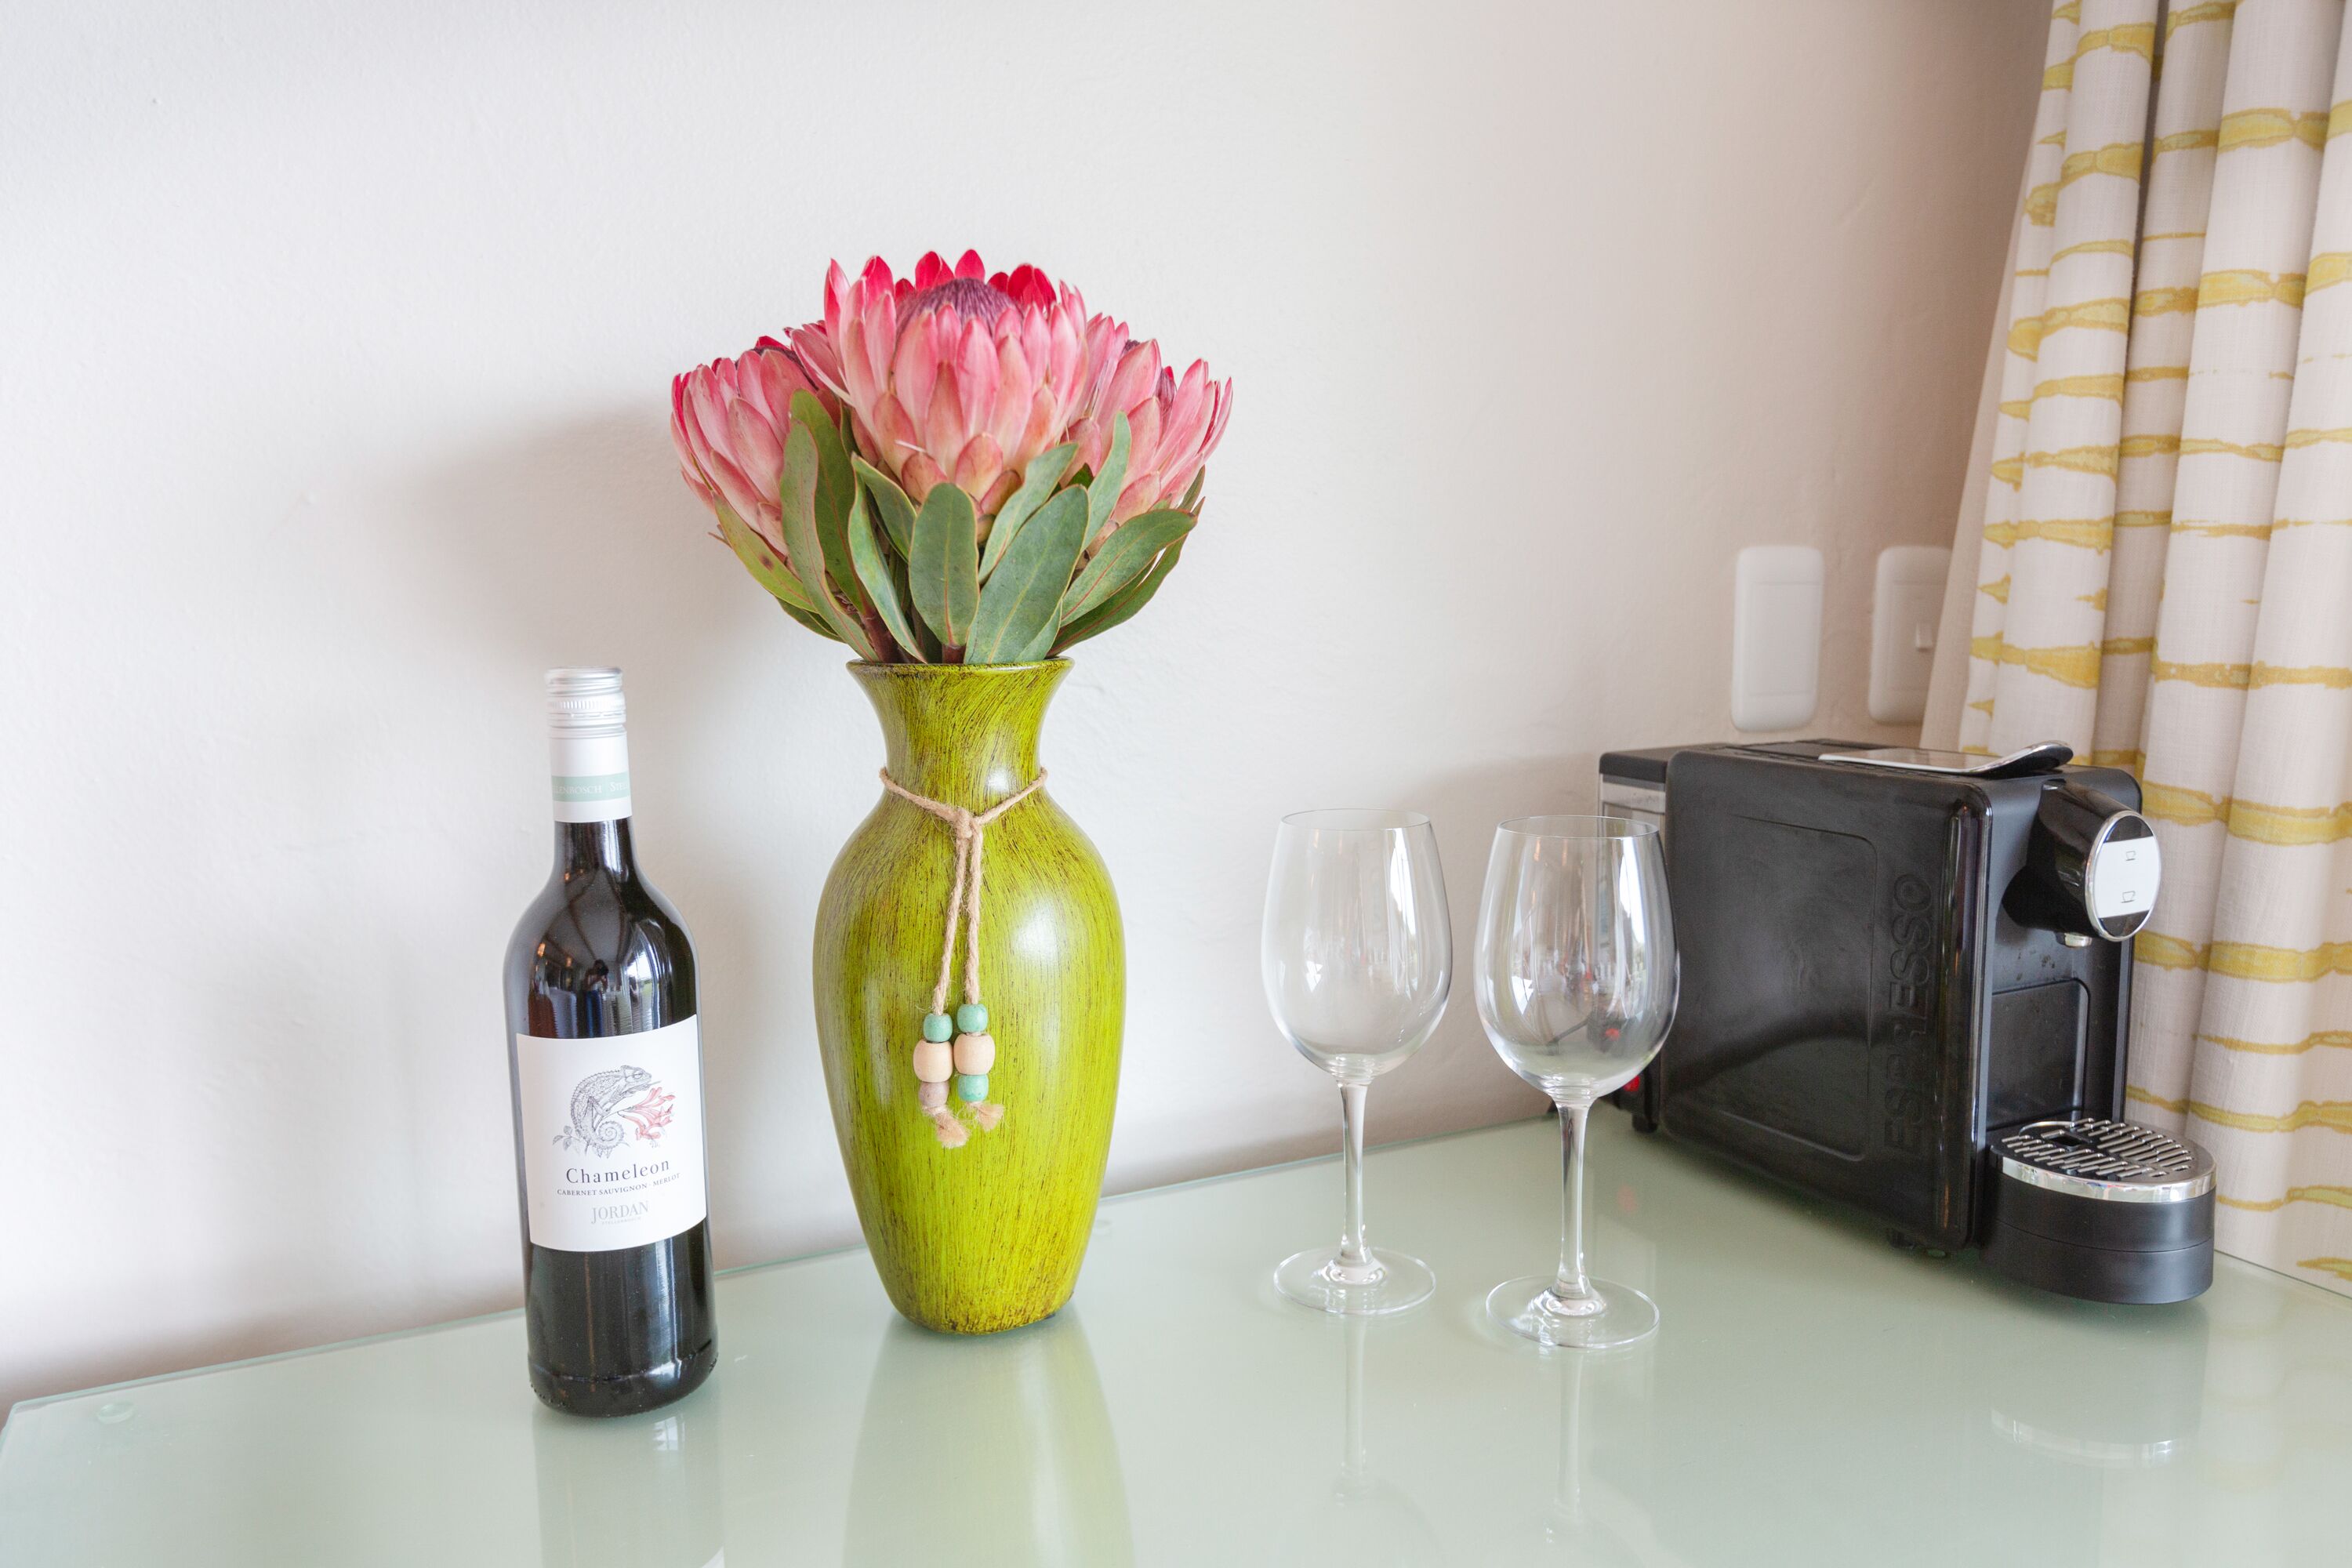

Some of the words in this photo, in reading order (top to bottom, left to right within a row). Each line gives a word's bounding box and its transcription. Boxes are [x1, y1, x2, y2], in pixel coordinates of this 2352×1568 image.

[1883, 873, 1933, 1156] ESPRESSO
[566, 1160, 670, 1184] Chameleon
[599, 1183, 648, 1196] SAUVIGNON
[652, 1172, 681, 1186] MERLOT
[591, 1201, 648, 1225] JORDAN
